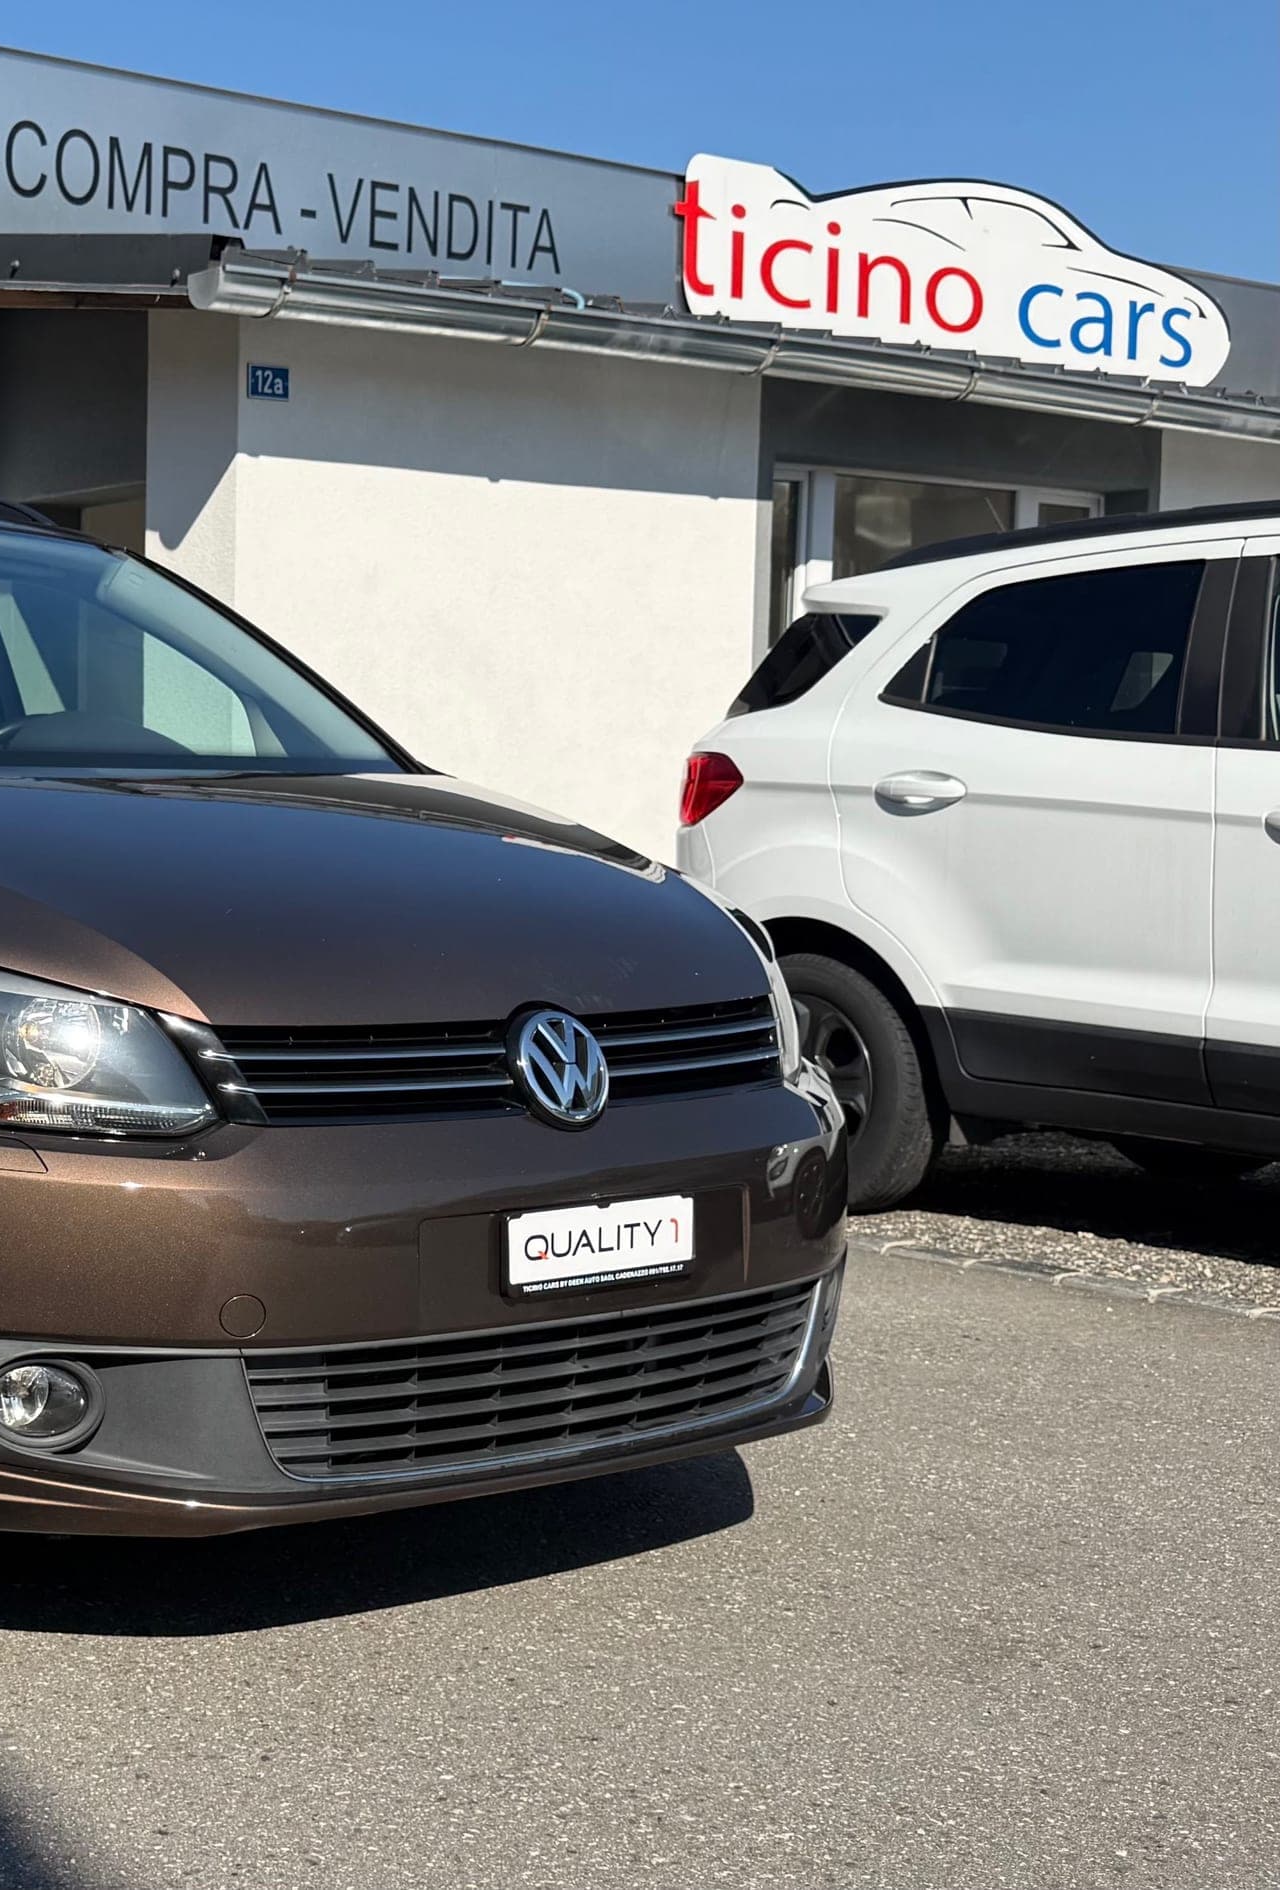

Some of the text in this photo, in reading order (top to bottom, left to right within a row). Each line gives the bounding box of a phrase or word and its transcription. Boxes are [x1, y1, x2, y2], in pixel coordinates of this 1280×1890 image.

[6, 120, 283, 235] COMPRA
[327, 173, 561, 275] VENDITA
[674, 180, 1193, 369] ticino cars
[255, 369, 285, 395] 12a
[524, 1219, 663, 1261] QUALITY
